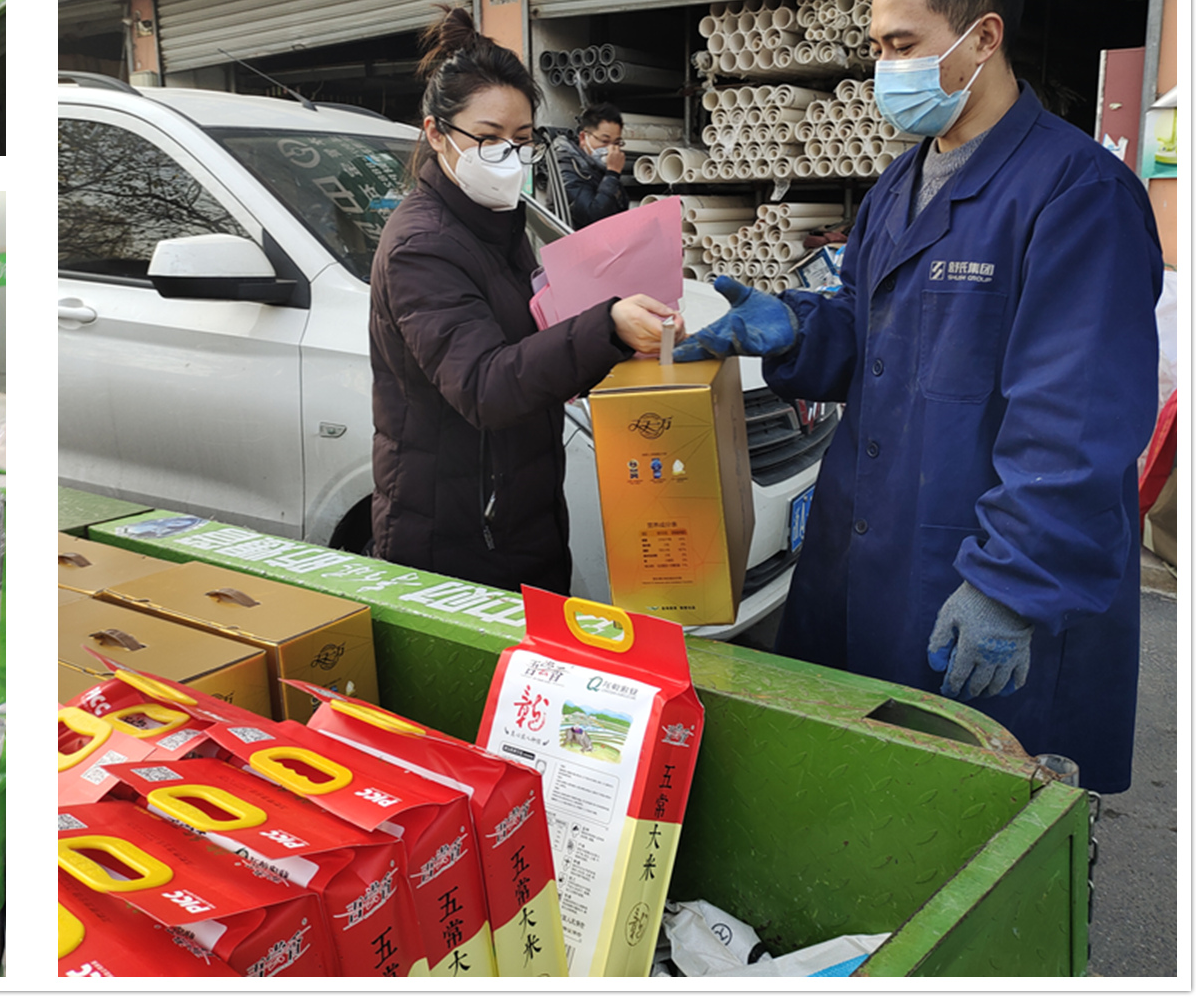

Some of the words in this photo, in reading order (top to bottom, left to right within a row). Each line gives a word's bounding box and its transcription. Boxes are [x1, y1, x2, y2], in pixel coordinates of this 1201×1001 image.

[354, 787, 398, 809] PICC
[642, 764, 676, 882] 五常大米
[259, 829, 306, 850] PICC
[161, 889, 212, 915] PICC
[436, 885, 472, 976] 五常大
[509, 845, 543, 968] 五常大米
